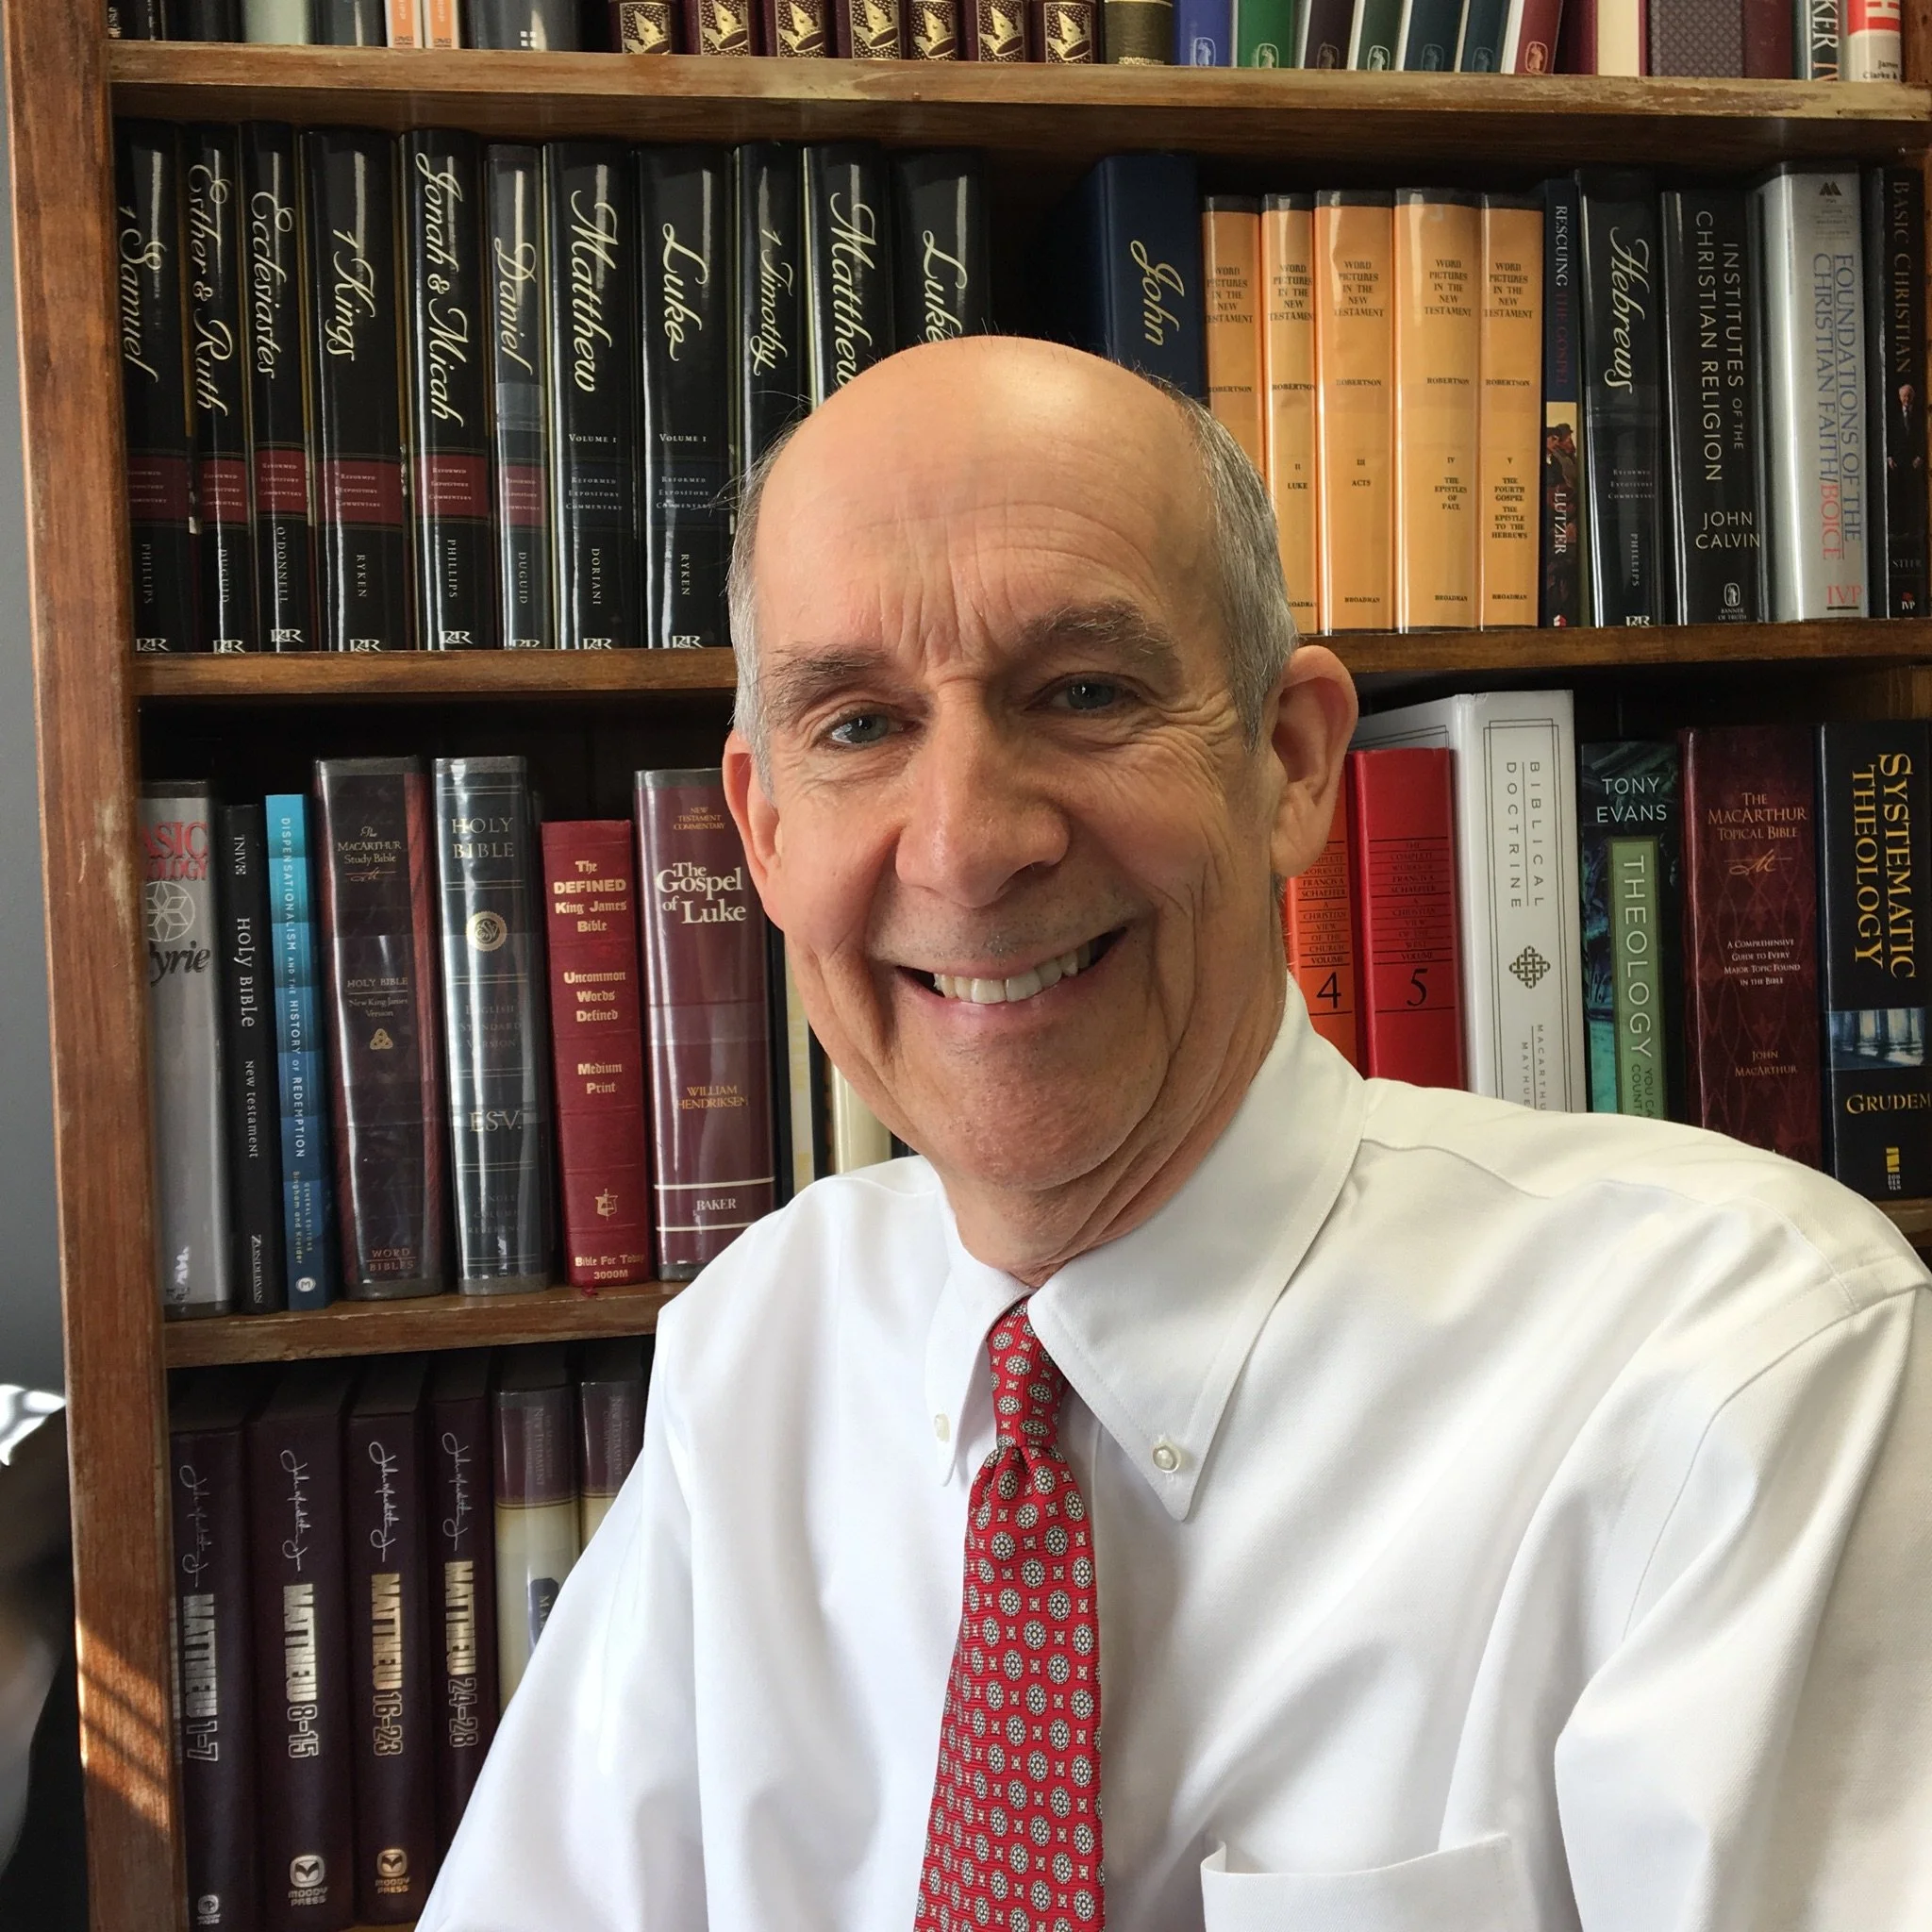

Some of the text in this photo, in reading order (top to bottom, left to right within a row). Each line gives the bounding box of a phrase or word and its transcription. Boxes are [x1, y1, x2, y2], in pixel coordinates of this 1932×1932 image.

[1556, 206, 1568, 287] RESCUING
[1429, 272, 1468, 280] PICTURES
[1435, 259, 1461, 269] WORD
[189, 164, 232, 416] Esther & Ruth
[251, 191, 295, 379] Ecclesiastes
[415, 152, 468, 427] Jonah & Micah
[1447, 283, 1463, 291] THE
[1892, 181, 1911, 374] BASIC CHRISTIAN
[325, 228, 375, 361] 1 Kings
[571, 191, 618, 392] Matthew
[662, 223, 708, 361] Luke
[1131, 240, 1185, 346] John
[1440, 294, 1458, 304] NEW
[119, 228, 167, 382] Samuel
[494, 237, 537, 375] Daniel
[750, 249, 793, 376] Timothy
[1424, 307, 1472, 316] TESTAMENT
[1605, 226, 1650, 393] Hebrews
[1813, 254, 1836, 392] CHRISTIAN
[1696, 211, 1723, 481] CHRISTIAN RELIGION
[1723, 243, 1743, 450] INSTITUTES OF THE
[1835, 253, 1858, 445] FOUNDATIONS
[568, 433, 608, 443] VOLUME
[659, 433, 698, 442] VOLUME
[1841, 453, 1860, 485] OF
[1434, 486, 1467, 494] EPISTLES
[1441, 503, 1460, 511] PAUL
[1843, 496, 1861, 541] THE
[1555, 491, 1567, 555] LUTZER
[1704, 511, 1753, 530] JOHN
[1695, 533, 1760, 549] CALVIN
[277, 526, 288, 604] O'DONNELL
[357, 554, 367, 597] RYKEN
[448, 539, 458, 598] PHILLIPS
[591, 548, 601, 605] DORIANI
[681, 554, 690, 595] RYKEN
[519, 552, 528, 604] DUGUID
[1826, 585, 1862, 605] IVP
[1602, 776, 1660, 794] TONY
[1741, 792, 1768, 805] THE
[451, 817, 513, 835] HOLY
[673, 822, 726, 830] COMMENTARY
[677, 813, 722, 823] TESTAMENT
[1596, 805, 1667, 823] EVANS
[360, 826, 376, 838] The
[1506, 762, 1521, 908] DOCTRINE
[1530, 762, 1544, 906] BIBLICAL
[1718, 826, 1797, 840] TOPICAL BIBLE
[344, 853, 396, 865] Study Bible
[453, 843, 514, 858] BIBLE
[575, 860, 598, 874] The
[673, 861, 708, 877] The
[1853, 764, 1883, 970] THEOLOGY
[1879, 754, 1915, 978] SYSTEMATIC
[281, 817, 296, 950] DISPENSATIONALISM
[553, 878, 626, 894] DEFINED
[658, 867, 743, 901] Gospel
[555, 900, 626, 915] King James
[662, 895, 747, 924] of Luke
[577, 920, 608, 933] Bible
[1736, 938, 1794, 948] COMPREHENSIVE
[1624, 856, 1652, 1058] THEOLOGY
[1724, 962, 1800, 974] MAJOR TOPIC FOUND
[1732, 952, 1754, 961] GUIDE
[1768, 951, 1790, 959] EVERY
[347, 977, 408, 989] HOLY BIBLE
[564, 971, 626, 984] Uncommon
[1406, 968, 1428, 1007] 5
[576, 990, 615, 1004] Words
[1316, 972, 1341, 1009] 4
[575, 1009, 618, 1023] Defined
[289, 1001, 301, 1057] HISTORY
[292, 1060, 300, 1072] OF
[577, 1061, 623, 1075] Medium
[1538, 1024, 1546, 1109] MACARTHU
[1752, 1051, 1778, 1061] JOHN
[586, 1081, 617, 1094] Print
[687, 1085, 738, 1096] WILLIAM
[676, 1096, 749, 1109] HENDRIKSEN
[1846, 1093, 1932, 1115] GRUDEM
[292, 1077, 304, 1158] REDEMPTION
[696, 1198, 736, 1211] BAKER
[372, 1248, 409, 1258] WORD
[575, 1254, 645, 1268] Bible For Today
[370, 1260, 414, 1272] BIBLES
[445, 1560, 475, 1675] MATTHEW
[283, 1583, 317, 1702] MATTHEW
[372, 1574, 402, 1690] MATTHEW
[183, 1594, 217, 1717] MATTHEW
[374, 1692, 403, 1756] 16-23
[448, 1677, 478, 1747] 24-28
[188, 1720, 219, 1761] 1-7
[287, 1705, 319, 1758] 8-15
[289, 1887, 328, 1898] MOODY
[291, 1896, 326, 1906] PRESS
